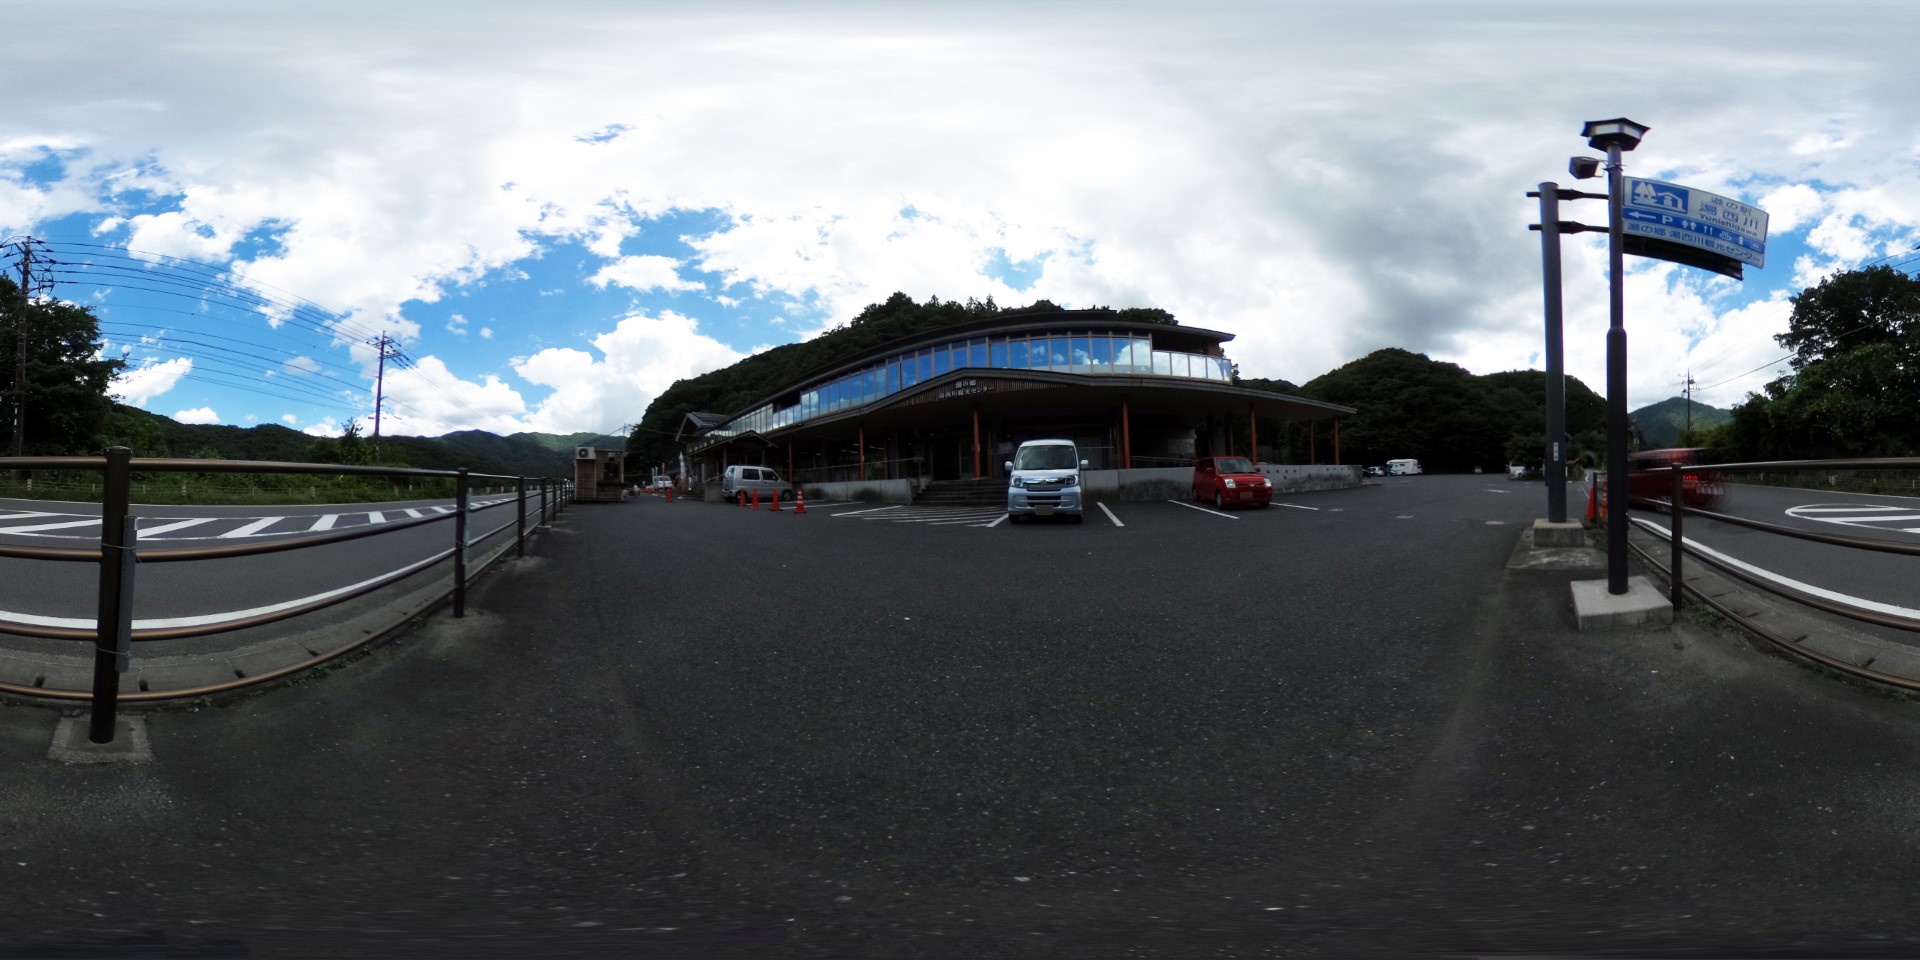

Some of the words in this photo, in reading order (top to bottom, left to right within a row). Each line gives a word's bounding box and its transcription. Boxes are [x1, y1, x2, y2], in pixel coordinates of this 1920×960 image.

[1699, 202, 1758, 230] 湯西川
[1711, 197, 1751, 214] 道の駅
[1661, 215, 1673, 224] P
[1699, 213, 1758, 237] Yunishigawa
[1627, 223, 1666, 236] 湯の郷
[1670, 230, 1761, 262] 湯西川観光センター
